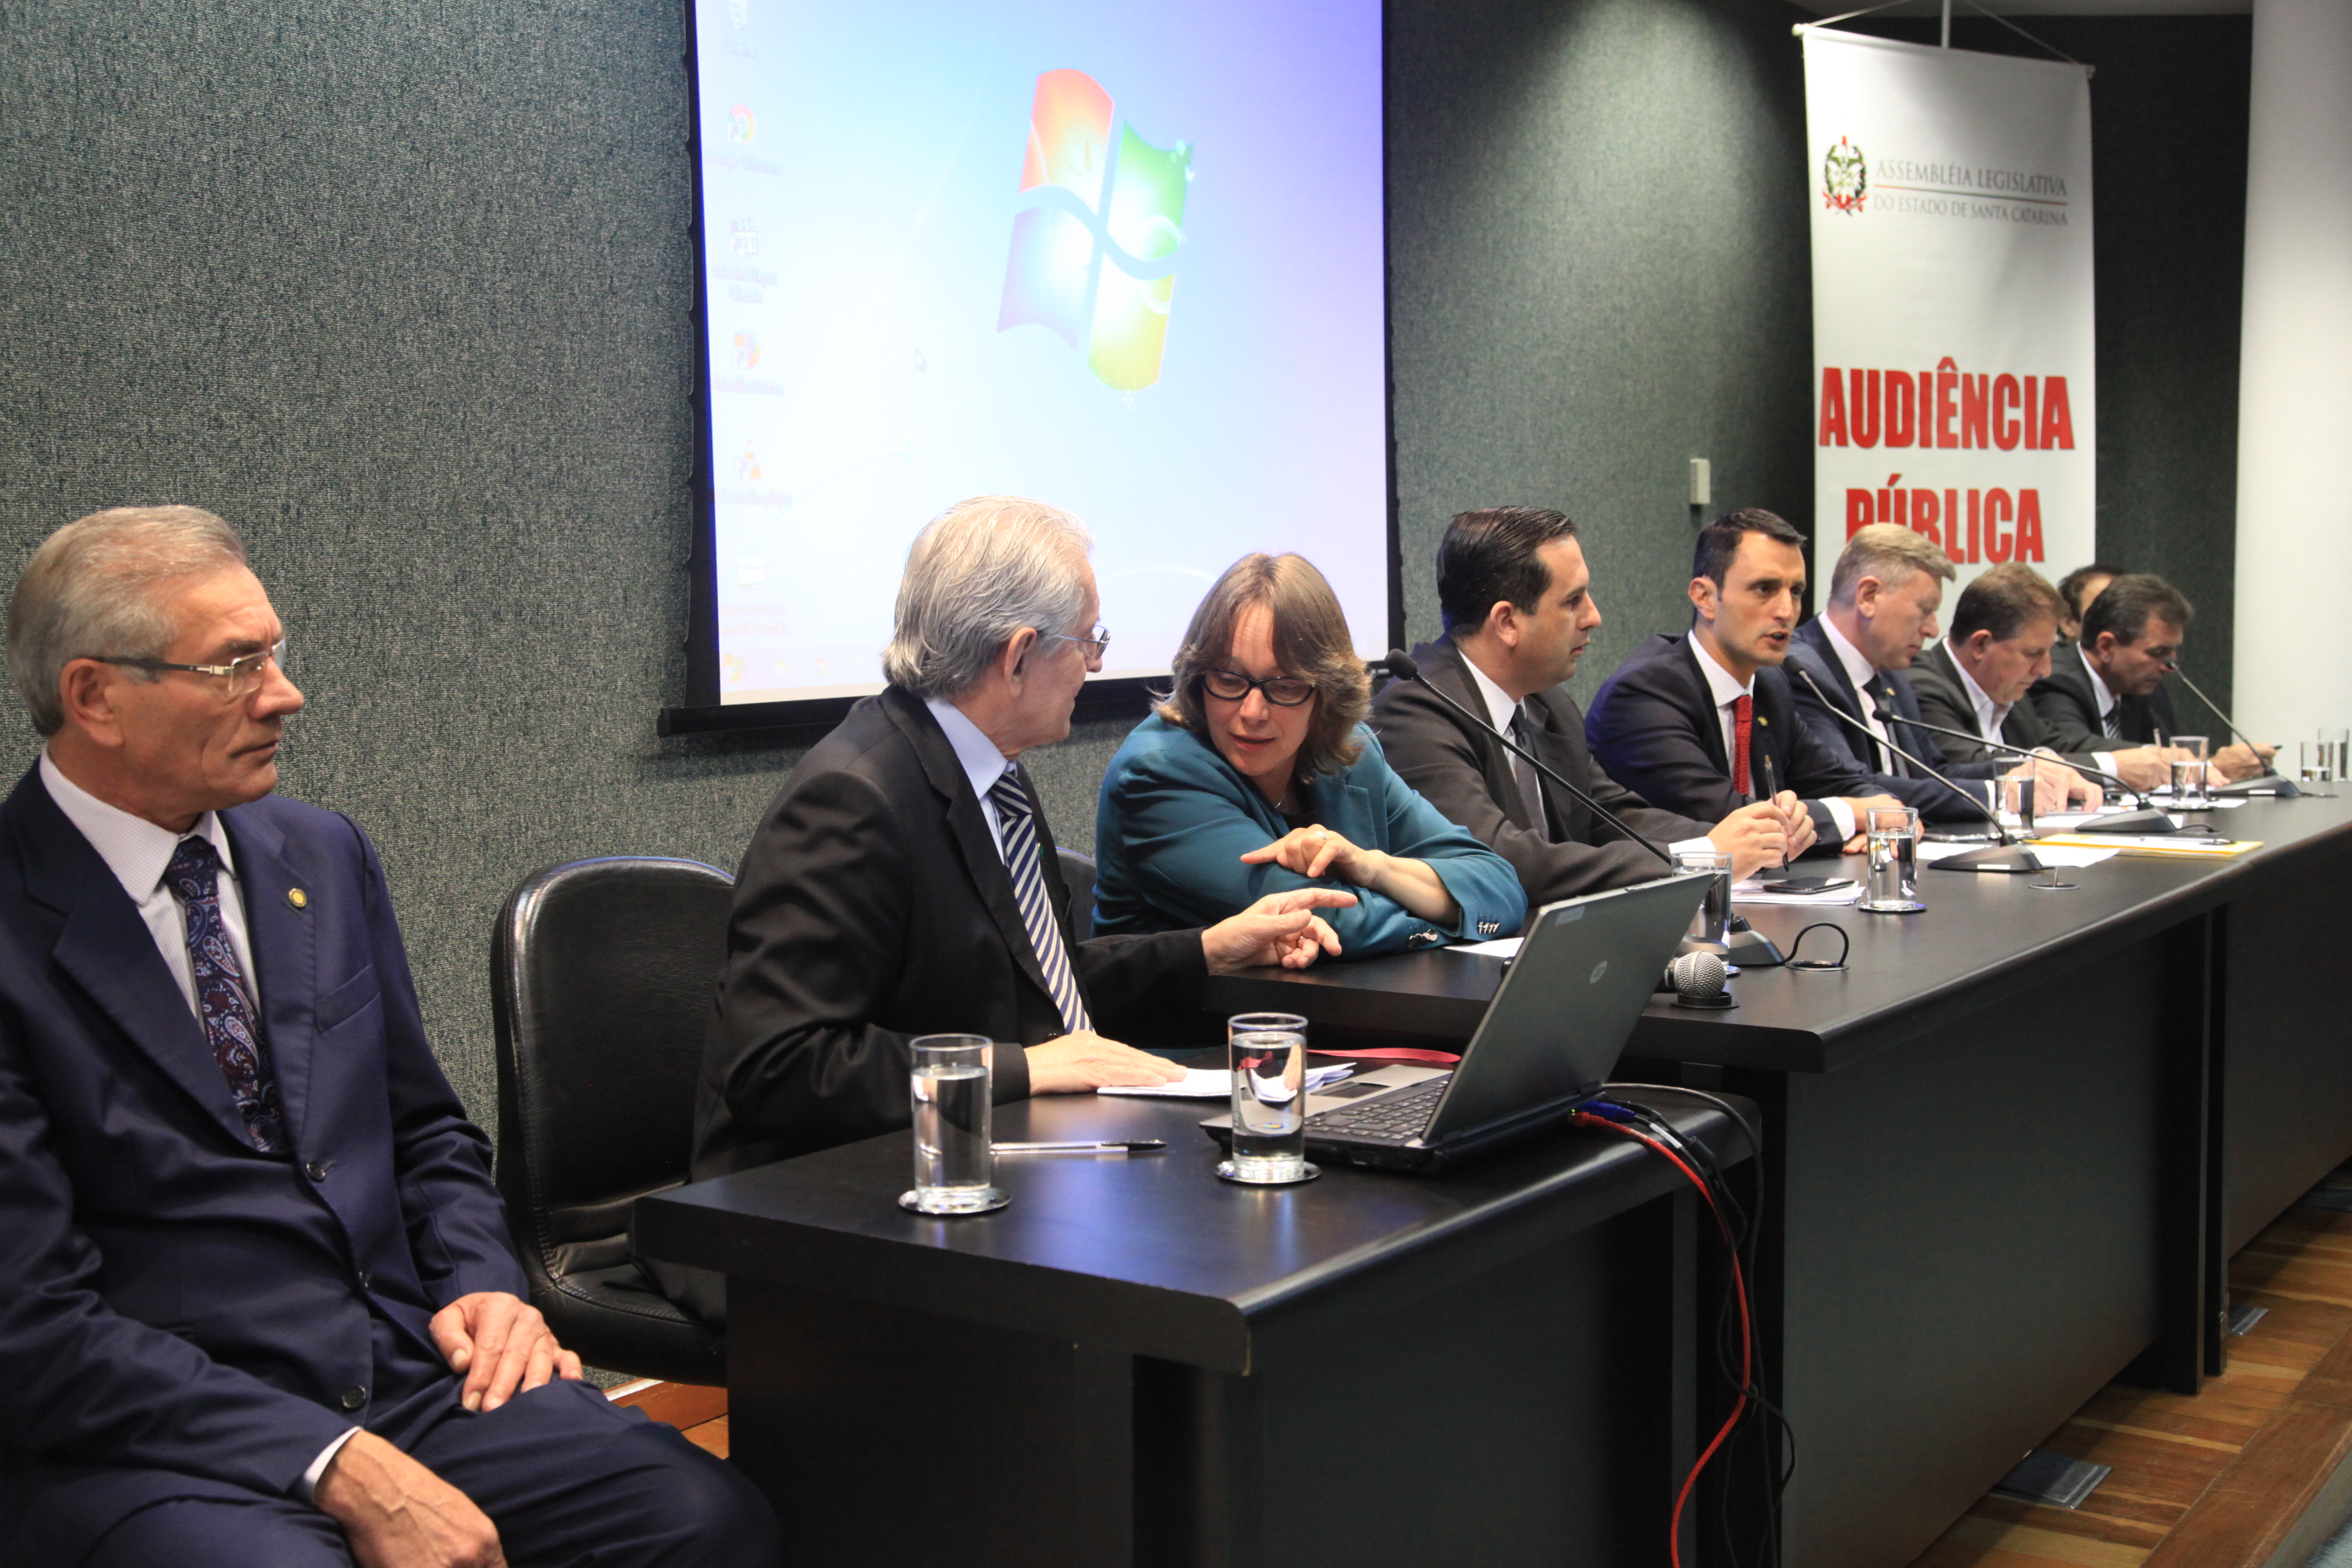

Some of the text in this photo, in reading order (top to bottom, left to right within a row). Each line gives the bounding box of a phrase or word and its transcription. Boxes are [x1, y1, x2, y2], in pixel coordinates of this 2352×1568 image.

[1876, 161, 2067, 196] ASSEMBLÉIA LEGISLATIVA
[1874, 194, 2068, 226] DO ESTADO DE SANTA CATARINA
[1820, 357, 2075, 450] AUDIÊNCIA
